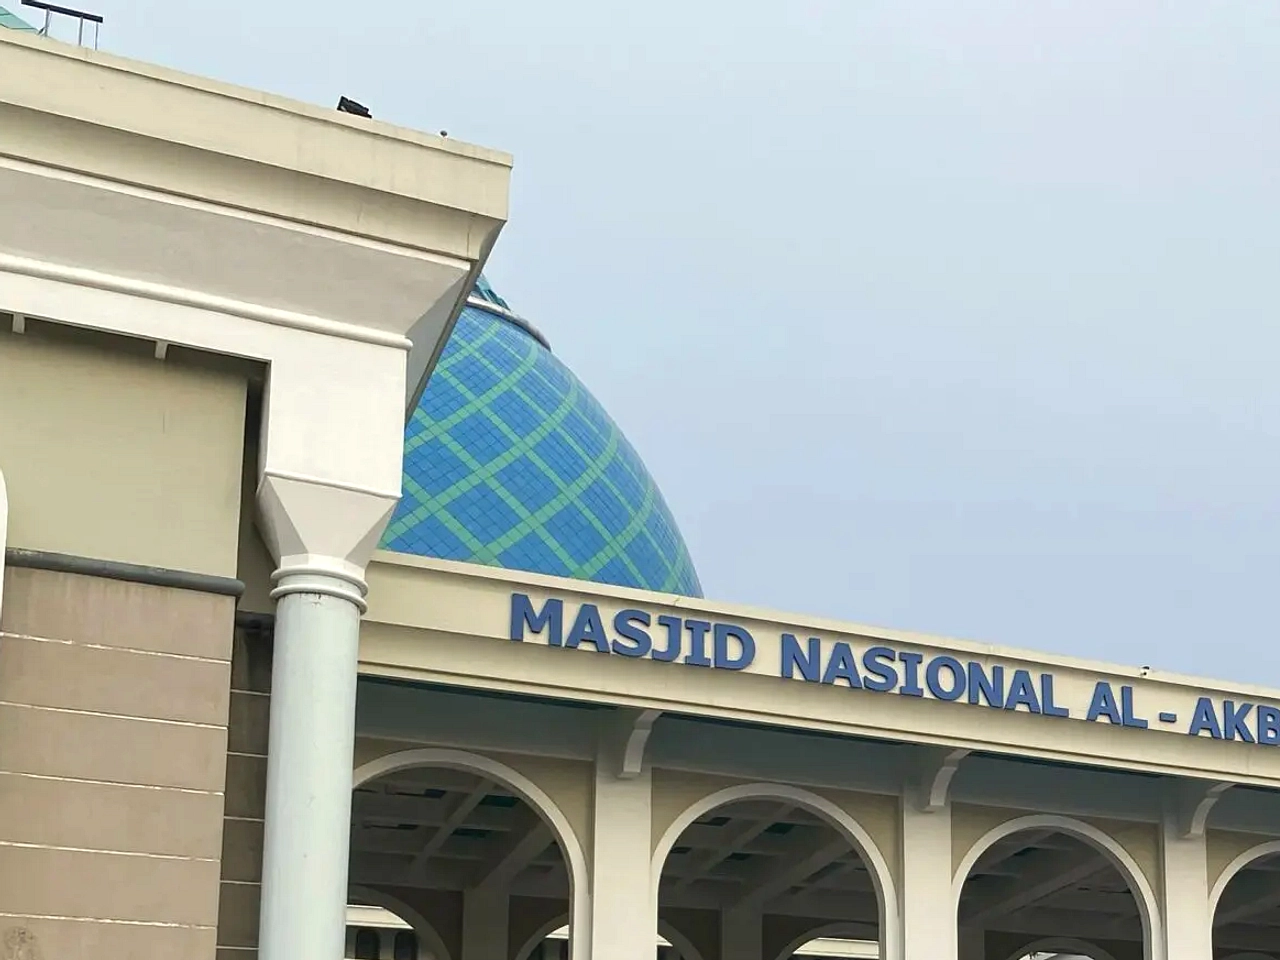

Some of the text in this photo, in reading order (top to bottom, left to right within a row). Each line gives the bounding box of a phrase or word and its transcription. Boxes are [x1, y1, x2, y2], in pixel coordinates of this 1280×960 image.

[510, 592, 756, 672] MASJID
[780, 633, 1070, 717] NASIONAL
[1086, 681, 1149, 729] AL
